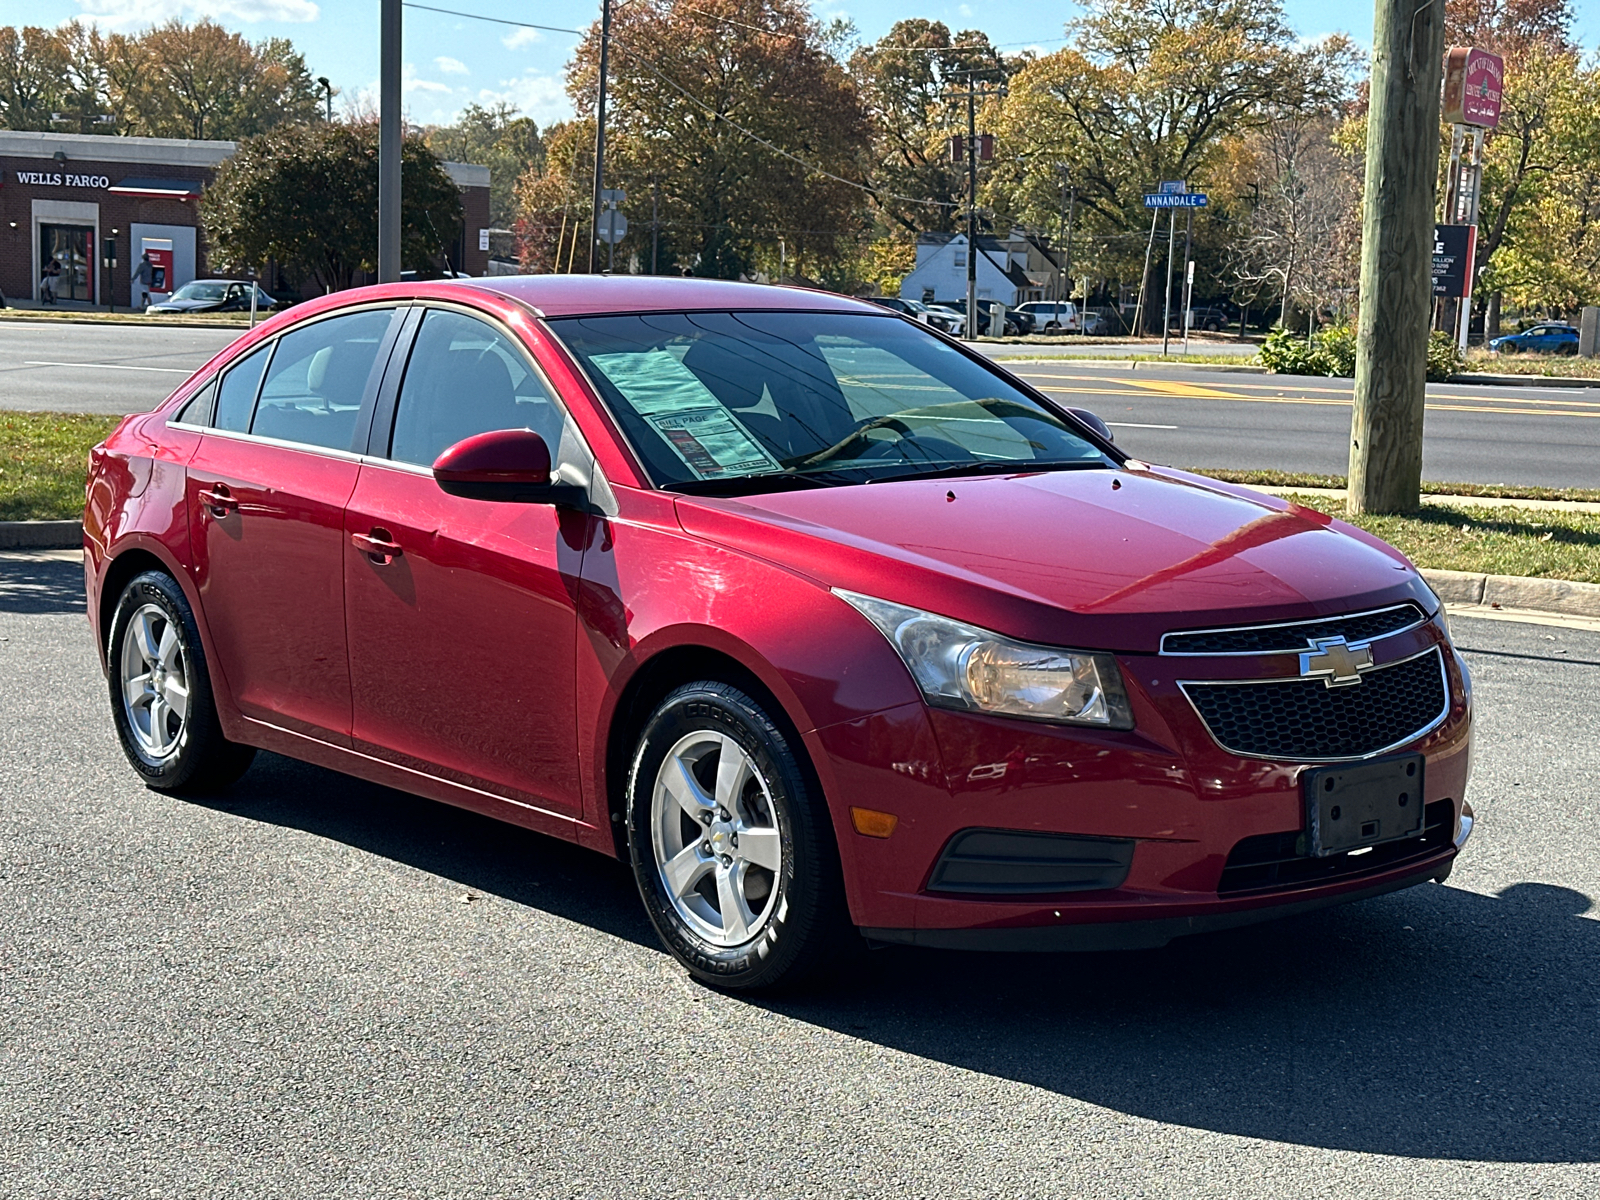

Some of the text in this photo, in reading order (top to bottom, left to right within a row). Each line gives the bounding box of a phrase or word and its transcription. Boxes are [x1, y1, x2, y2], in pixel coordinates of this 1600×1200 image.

[17, 172, 109, 188] WELLS FARGO
[1145, 195, 1197, 206] ANNANDALE
[682, 415, 709, 424] PAGE
